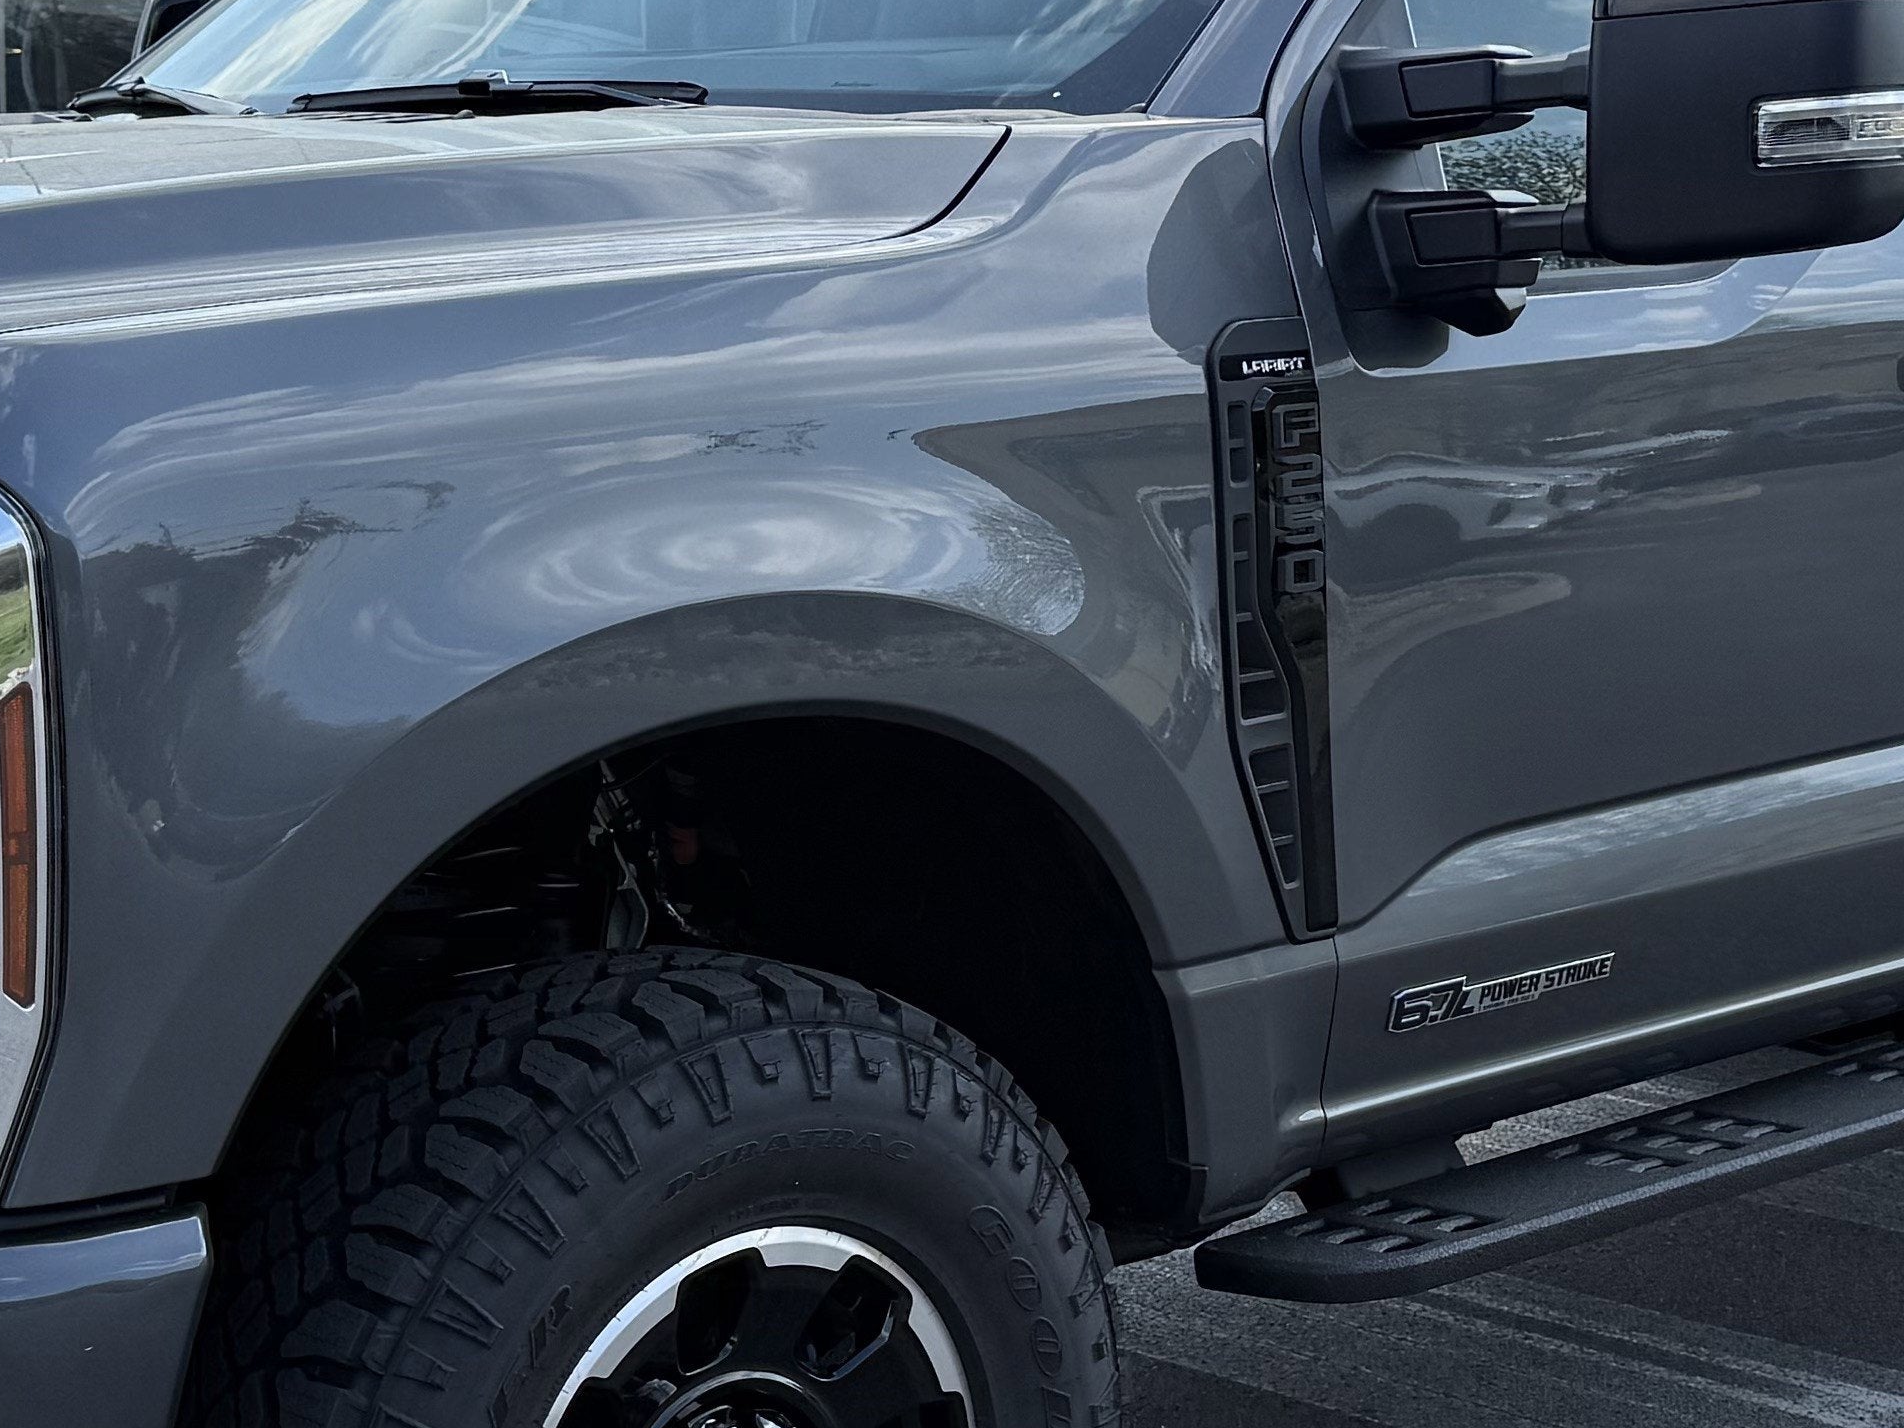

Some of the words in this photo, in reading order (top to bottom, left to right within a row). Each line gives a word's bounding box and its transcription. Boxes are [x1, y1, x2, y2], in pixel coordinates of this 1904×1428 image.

[1241, 356, 1305, 375] LARIAT
[1390, 978, 1476, 1031] 6.7L
[1478, 974, 1541, 1006] POWER
[1542, 956, 1611, 991] STROKE
[658, 1128, 916, 1204] DURATRAC
